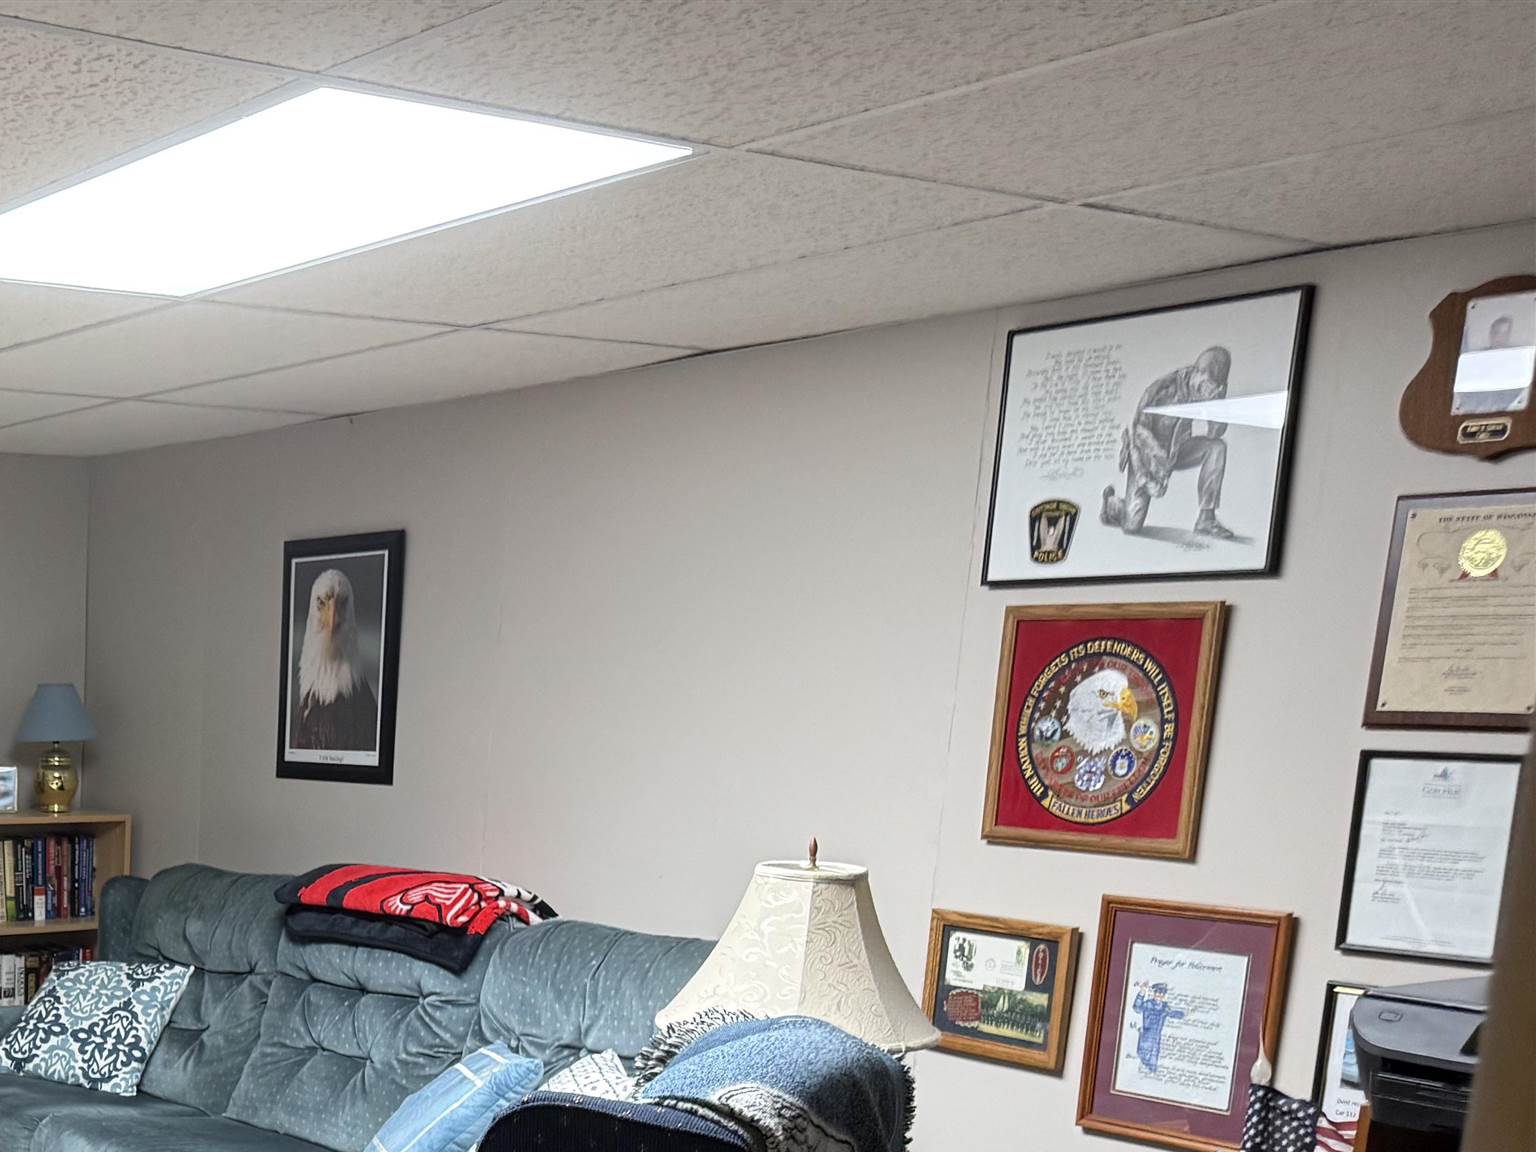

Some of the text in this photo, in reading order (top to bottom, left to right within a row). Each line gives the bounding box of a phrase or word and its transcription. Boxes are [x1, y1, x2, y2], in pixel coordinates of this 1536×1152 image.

[1033, 549, 1064, 562] POLICE
[1070, 644, 1086, 661] ITS
[1086, 640, 1145, 665] DEFENDERS
[1030, 653, 1070, 697] FORGETS
[1143, 657, 1163, 686] WILL
[1155, 683, 1176, 721] ITSELF
[1017, 696, 1037, 736] WHICH
[1162, 721, 1176, 740] BE
[1017, 736, 1034, 780] NATION
[1132, 739, 1174, 803] FORGOTTEN
[1028, 775, 1044, 797] THE
[1051, 801, 1121, 819] FALLEN HEROES
